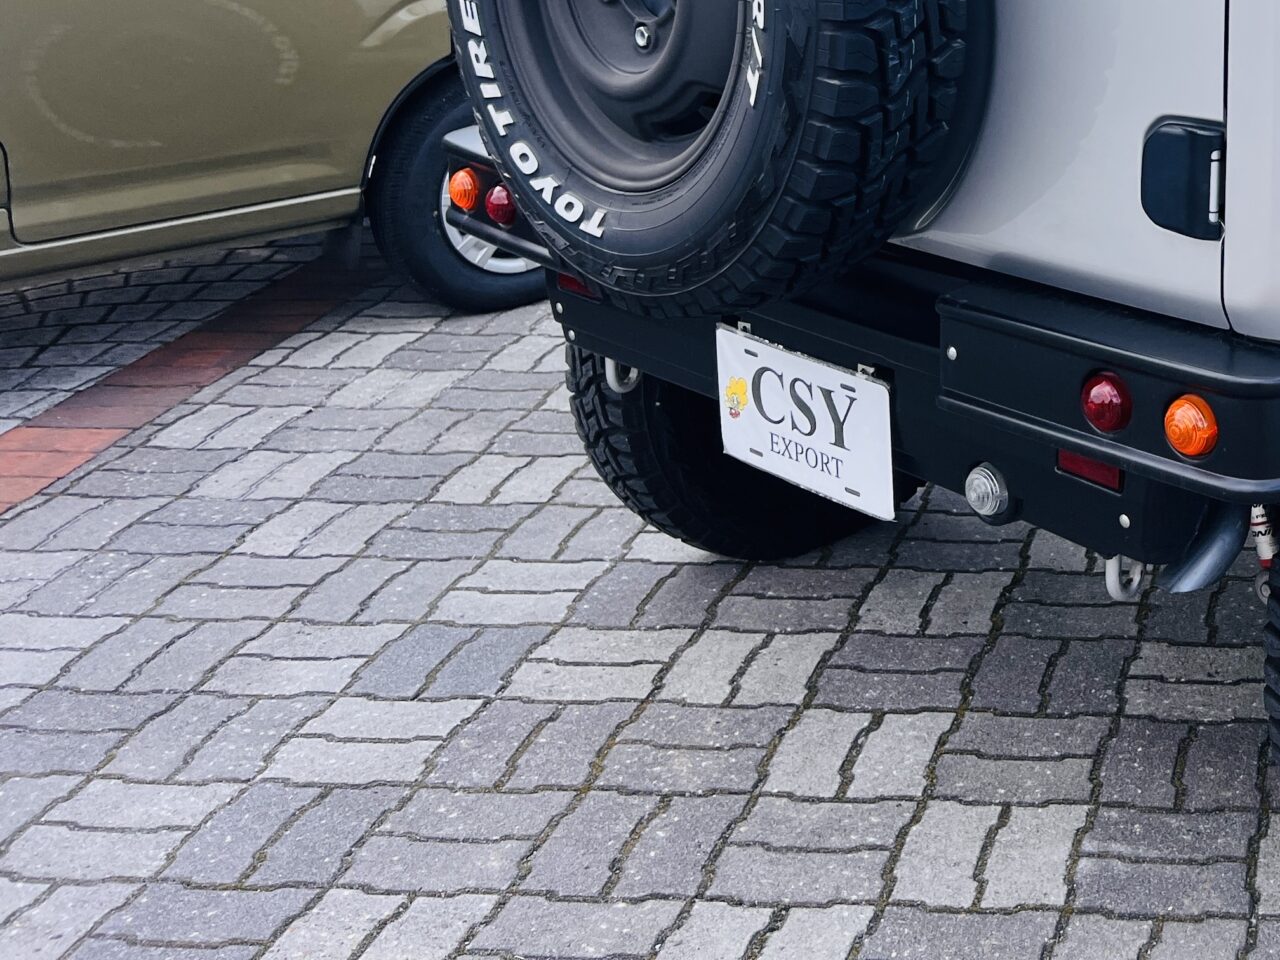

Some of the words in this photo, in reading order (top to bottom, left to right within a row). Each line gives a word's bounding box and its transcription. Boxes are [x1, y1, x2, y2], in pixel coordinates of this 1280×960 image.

[509, 142, 607, 238] TOYO
[751, 366, 857, 451] CSY
[769, 431, 843, 479] EXPORT
